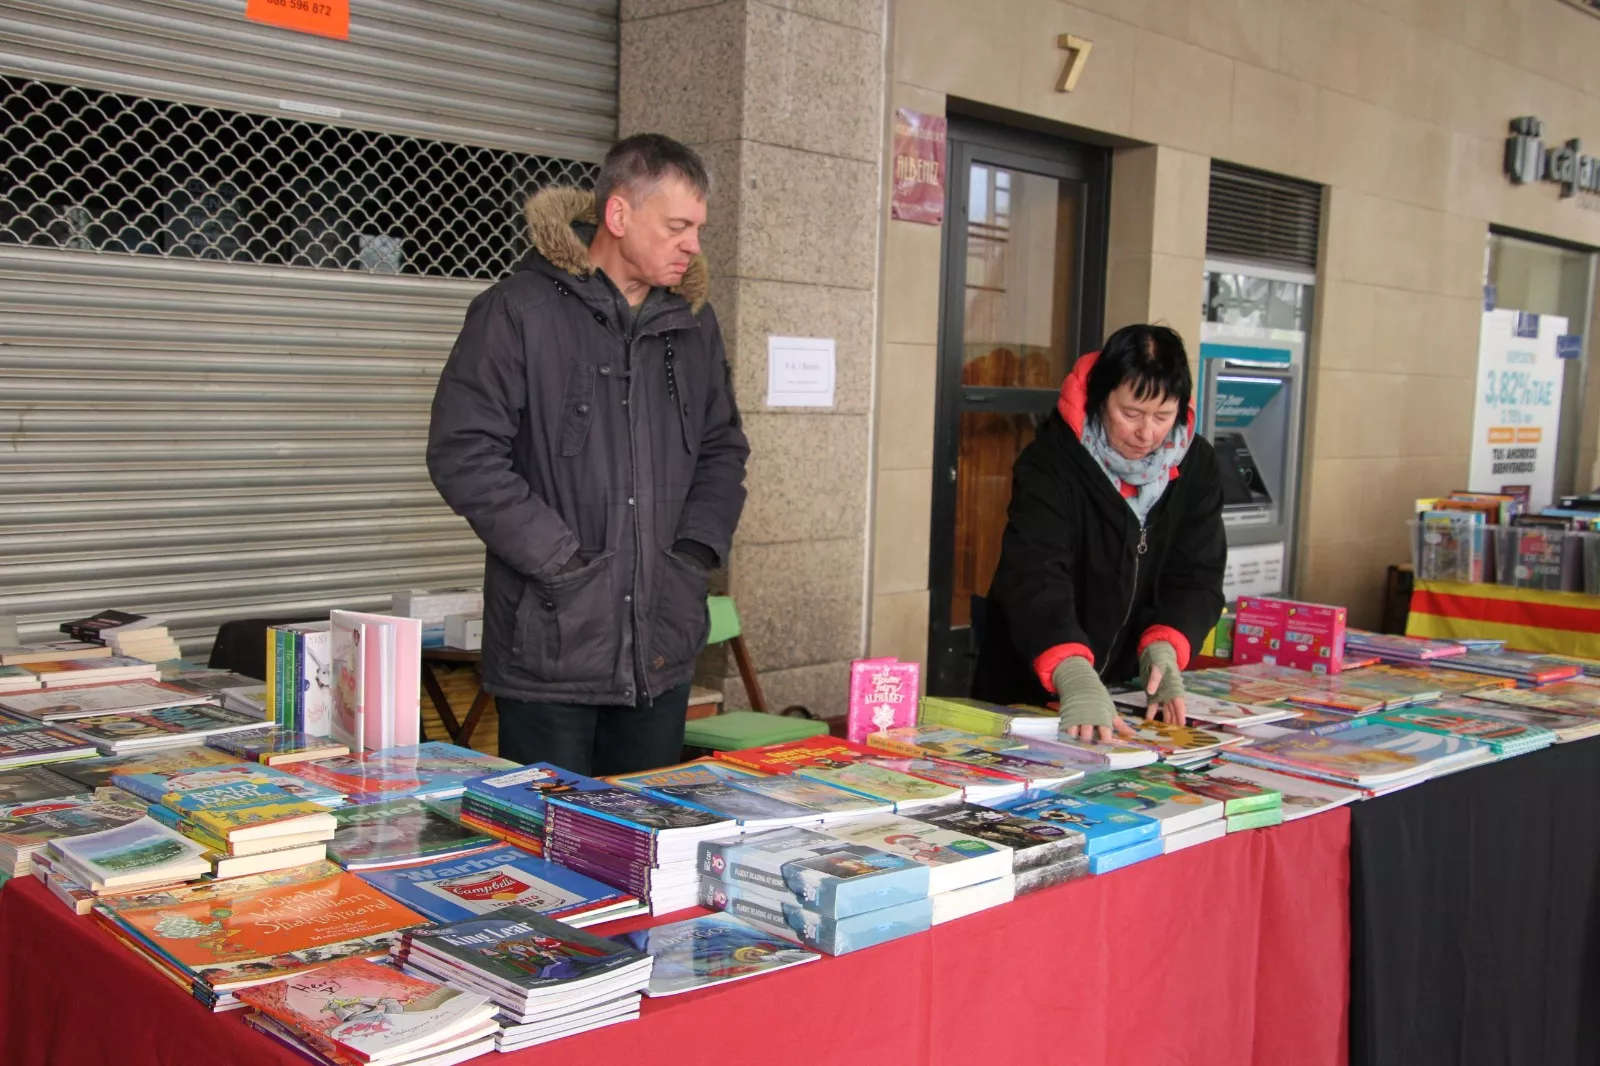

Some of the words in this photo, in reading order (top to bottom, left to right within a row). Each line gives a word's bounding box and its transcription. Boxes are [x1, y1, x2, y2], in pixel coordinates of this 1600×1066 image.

[312, 3, 331, 17] 872
[1057, 33, 1093, 91] 7
[190, 783, 261, 801] ROALD
[201, 787, 271, 805] DAHL
[399, 850, 530, 881] Warhol
[749, 871, 766, 882] READING
[286, 893, 373, 916] William
[490, 893, 540, 908] TOMATO
[750, 906, 767, 918] READING
[438, 926, 490, 947] King
[490, 919, 536, 941] Lear
